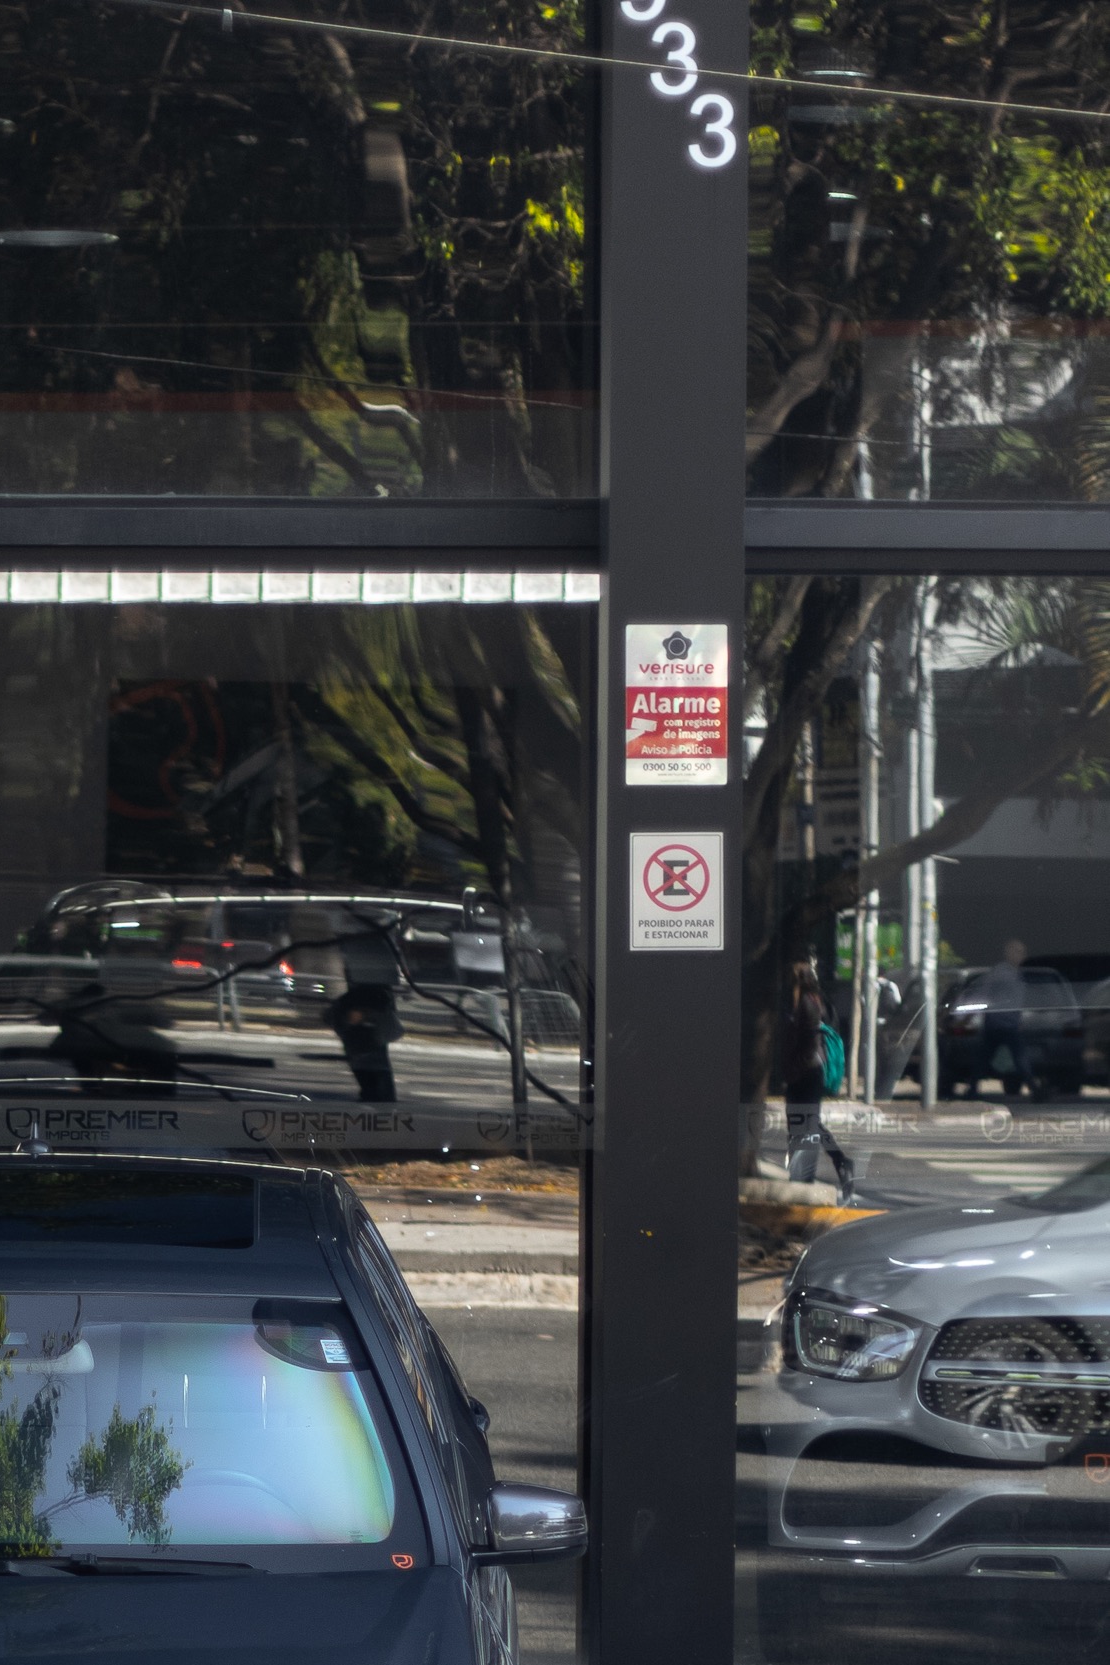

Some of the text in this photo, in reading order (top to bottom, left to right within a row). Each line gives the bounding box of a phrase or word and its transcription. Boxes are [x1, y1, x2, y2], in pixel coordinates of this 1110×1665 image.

[639, 663, 715, 675] verisure
[633, 692, 721, 714] Alarme
[663, 717, 721, 729] com registro
[663, 729, 721, 741] de imagens
[641, 744, 668, 755] Aviso
[642, 763, 712, 771] 0300 50 50 500
[638, 919, 715, 928] PROIBIDO PARAR
[644, 931, 709, 939] E ESTACIONAR
[45, 1109, 181, 1130] PREMIER
[281, 1111, 416, 1132] PREMIER
[45, 1130, 110, 1141] IMPORTS
